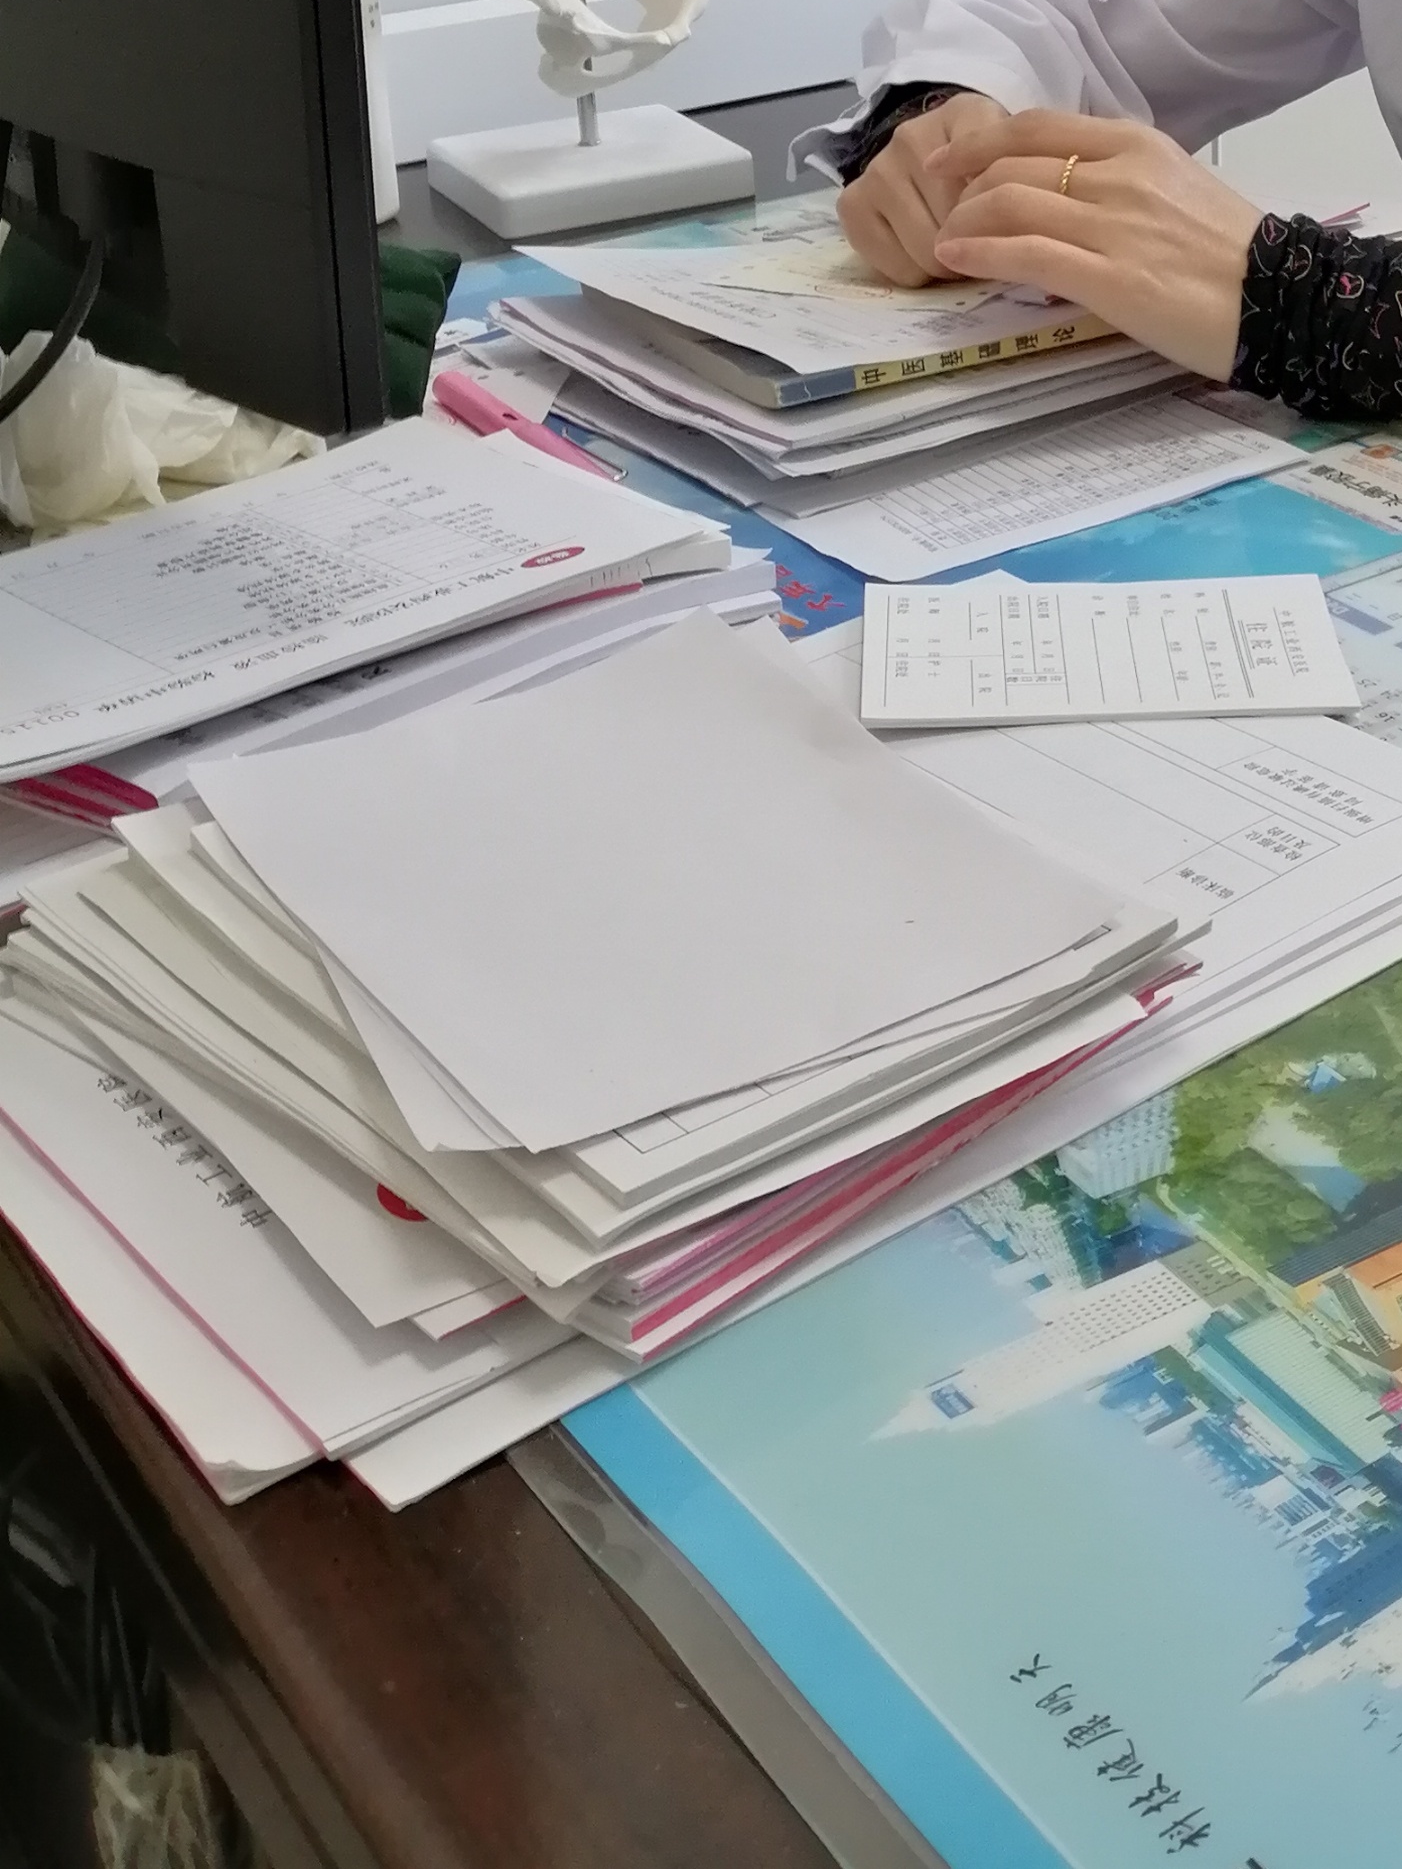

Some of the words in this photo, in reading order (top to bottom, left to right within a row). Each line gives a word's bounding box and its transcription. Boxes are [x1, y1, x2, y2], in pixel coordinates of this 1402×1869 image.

[1246, 622, 1278, 667] 住院证
[1010, 1654, 1210, 1853] 科技健康明天
